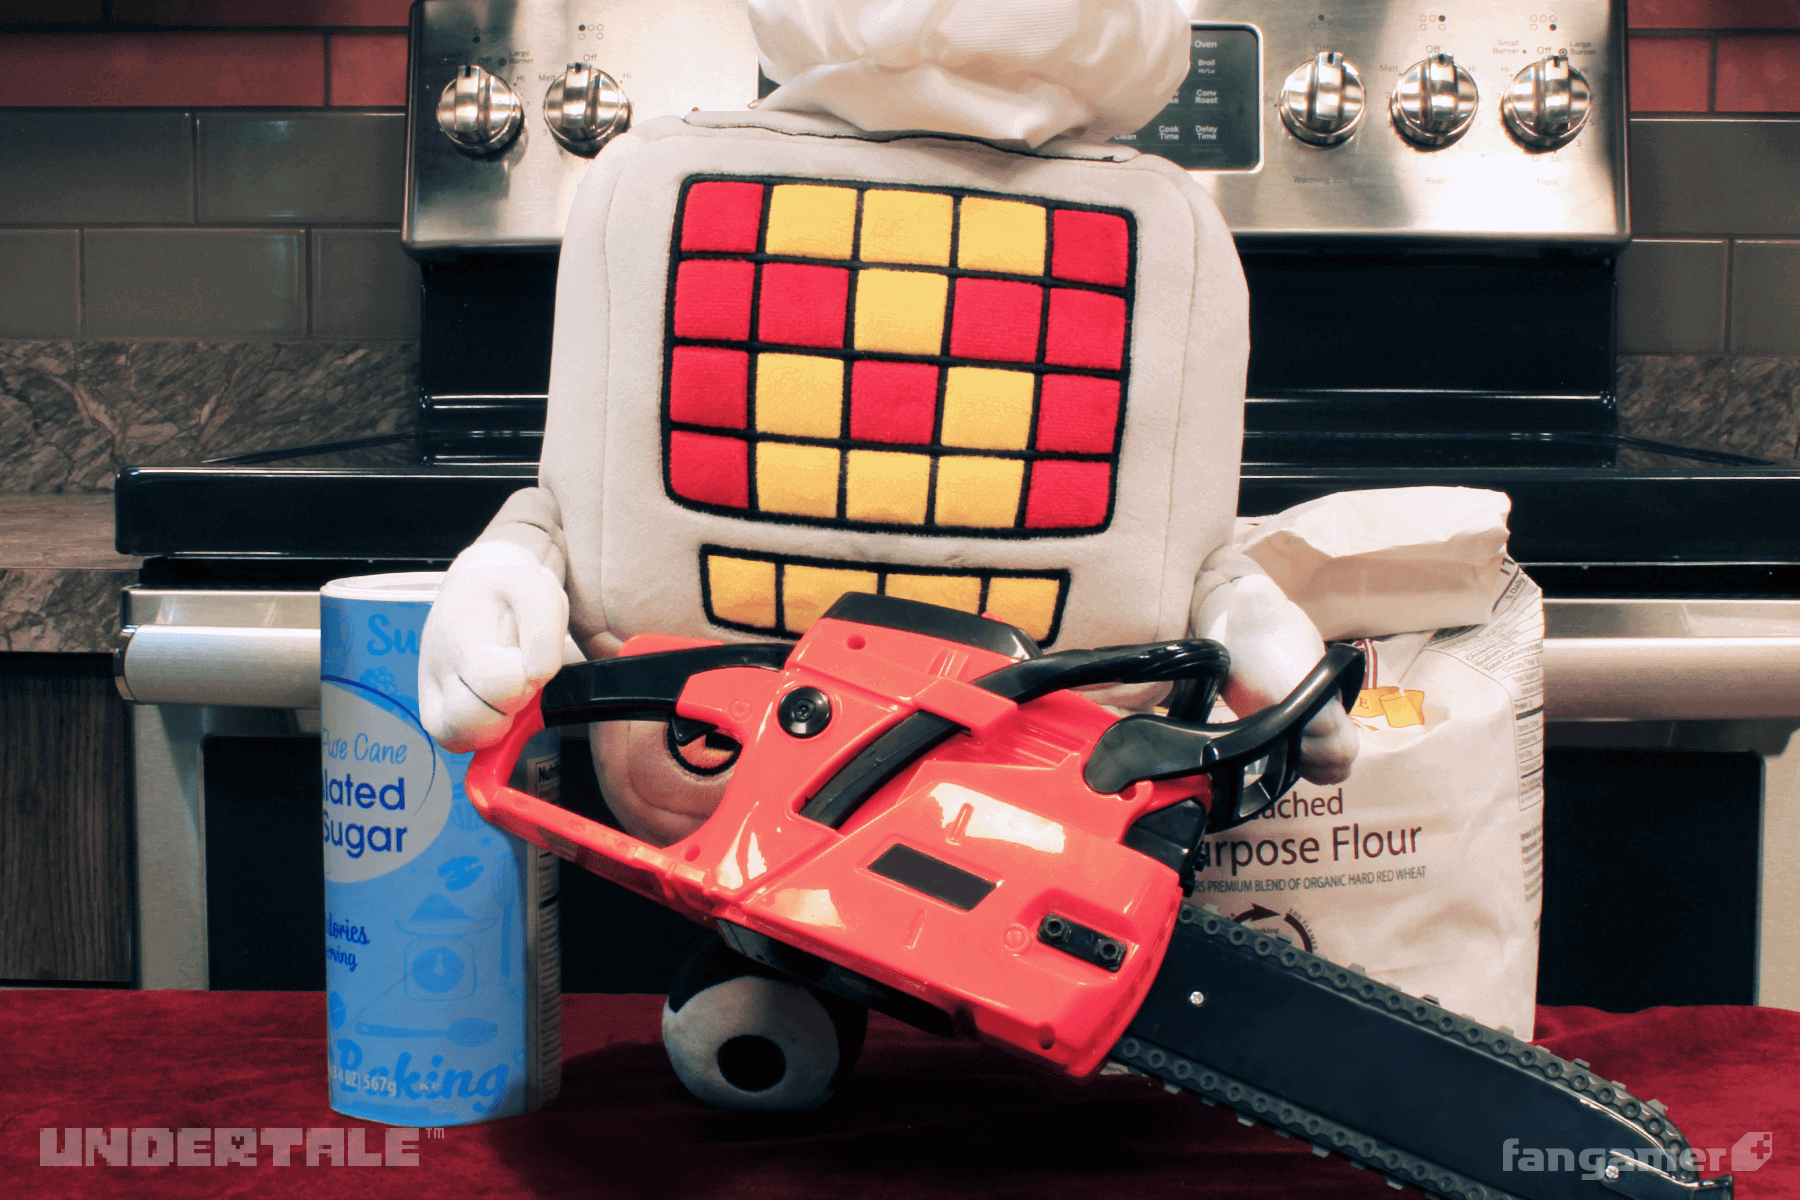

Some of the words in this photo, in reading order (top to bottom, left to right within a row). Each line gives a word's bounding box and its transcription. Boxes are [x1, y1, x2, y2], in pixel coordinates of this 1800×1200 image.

[1194, 40, 1217, 49] Oven
[1497, 39, 1520, 47] Small
[1569, 40, 1592, 49] Large
[1425, 45, 1441, 54] Off
[1492, 47, 1519, 55] Burner
[1536, 46, 1552, 55] Off
[583, 54, 598, 62] Off
[1197, 59, 1216, 67] Broil
[1196, 89, 1217, 97] Conv
[1194, 96, 1219, 104] Roast
[1158, 125, 1180, 133] Cook
[1195, 125, 1218, 134] Delay
[1159, 132, 1180, 140] Time
[1198, 132, 1217, 140] Time
[353, 732, 408, 765] Cane
[323, 809, 408, 859] Sugar
[1332, 823, 1422, 862] Flour
[1207, 879, 1253, 893] PREMIUM
[1254, 876, 1287, 892] BLEND
[1288, 876, 1301, 890] OF
[1303, 873, 1346, 890] ORGANIC
[1348, 870, 1375, 887] HARD
[1376, 868, 1395, 883] RED
[1395, 865, 1427, 881] WHEAT
[363, 1073, 397, 1098] 567g
